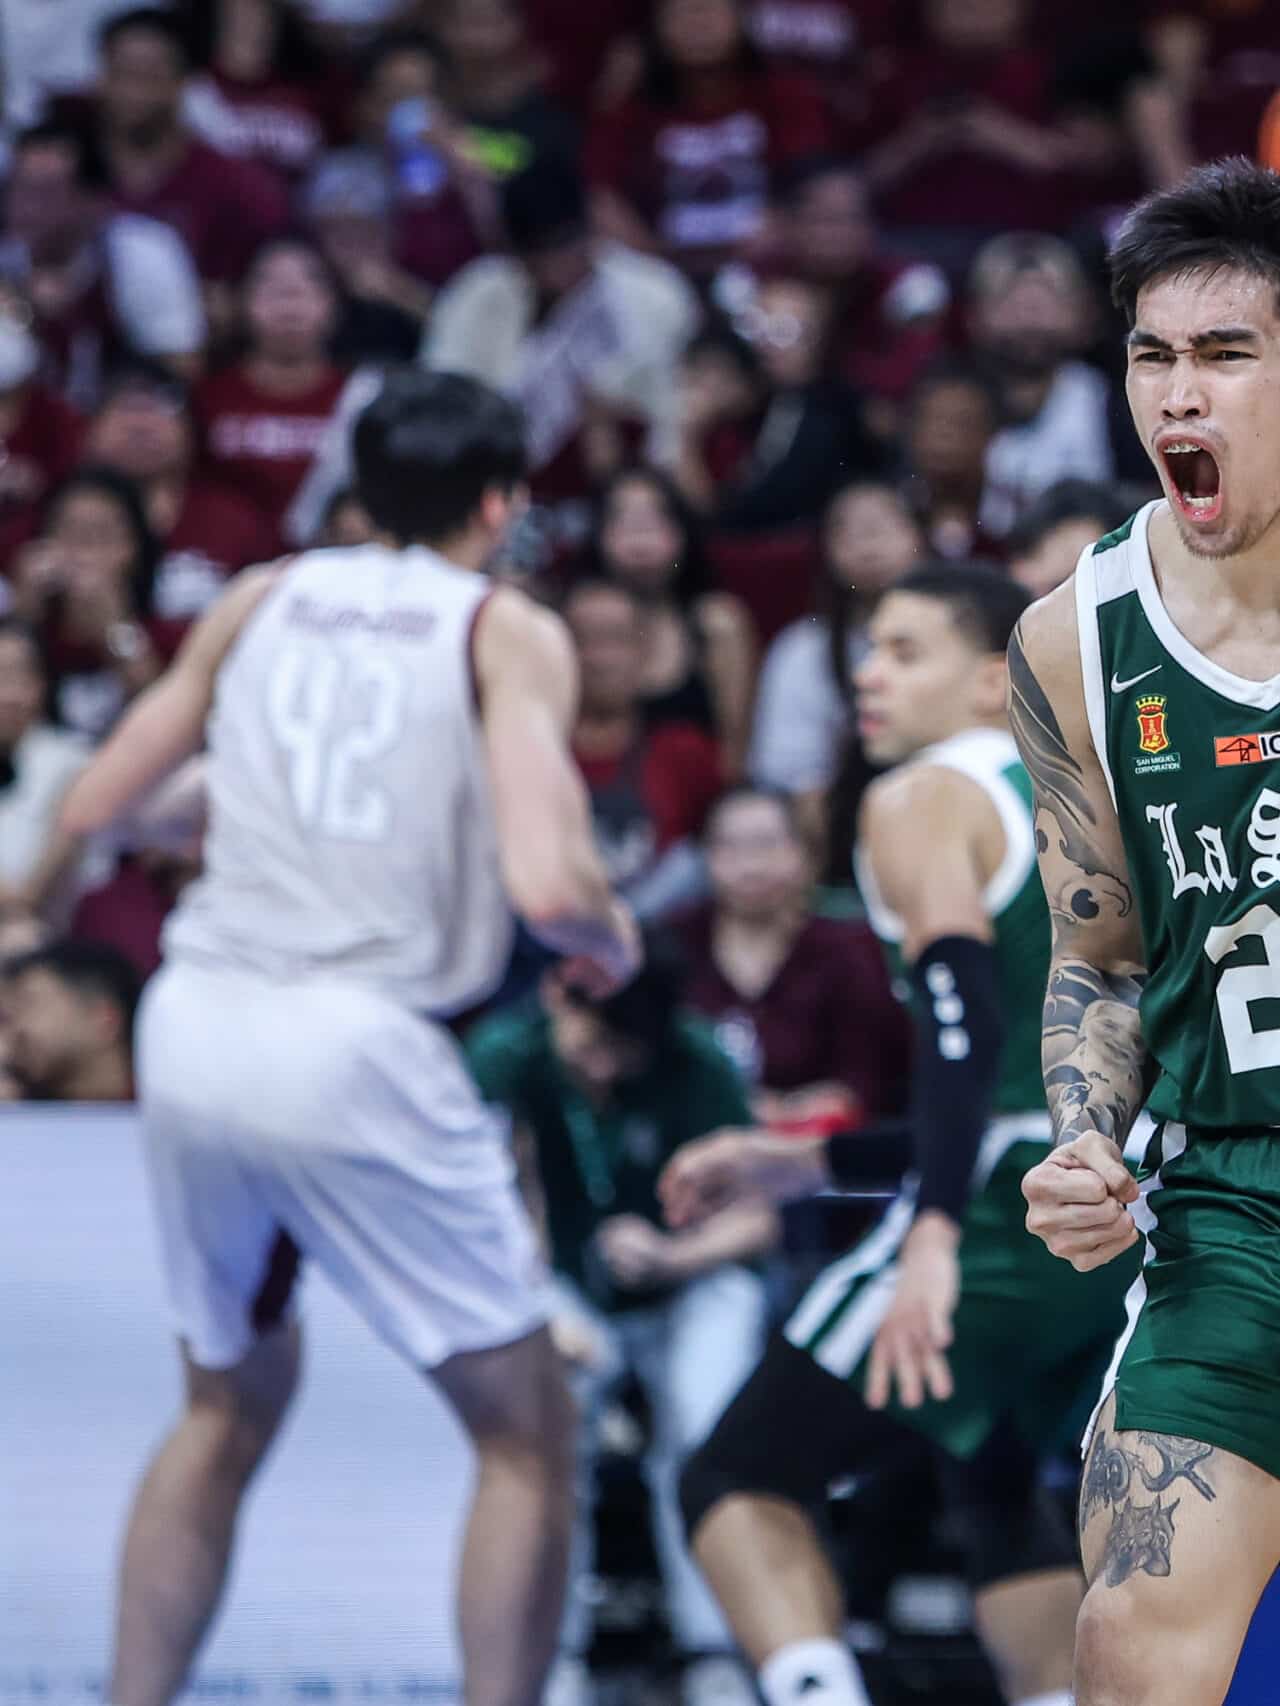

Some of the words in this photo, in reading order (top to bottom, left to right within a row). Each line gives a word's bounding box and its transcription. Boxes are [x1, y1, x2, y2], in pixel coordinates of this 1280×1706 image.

[267, 648, 402, 838] 42
[1135, 762, 1180, 774] CORPORATION
[1136, 758, 1150, 766] SAN
[1150, 754, 1176, 764] MIGUEL
[1145, 802, 1238, 900] La
